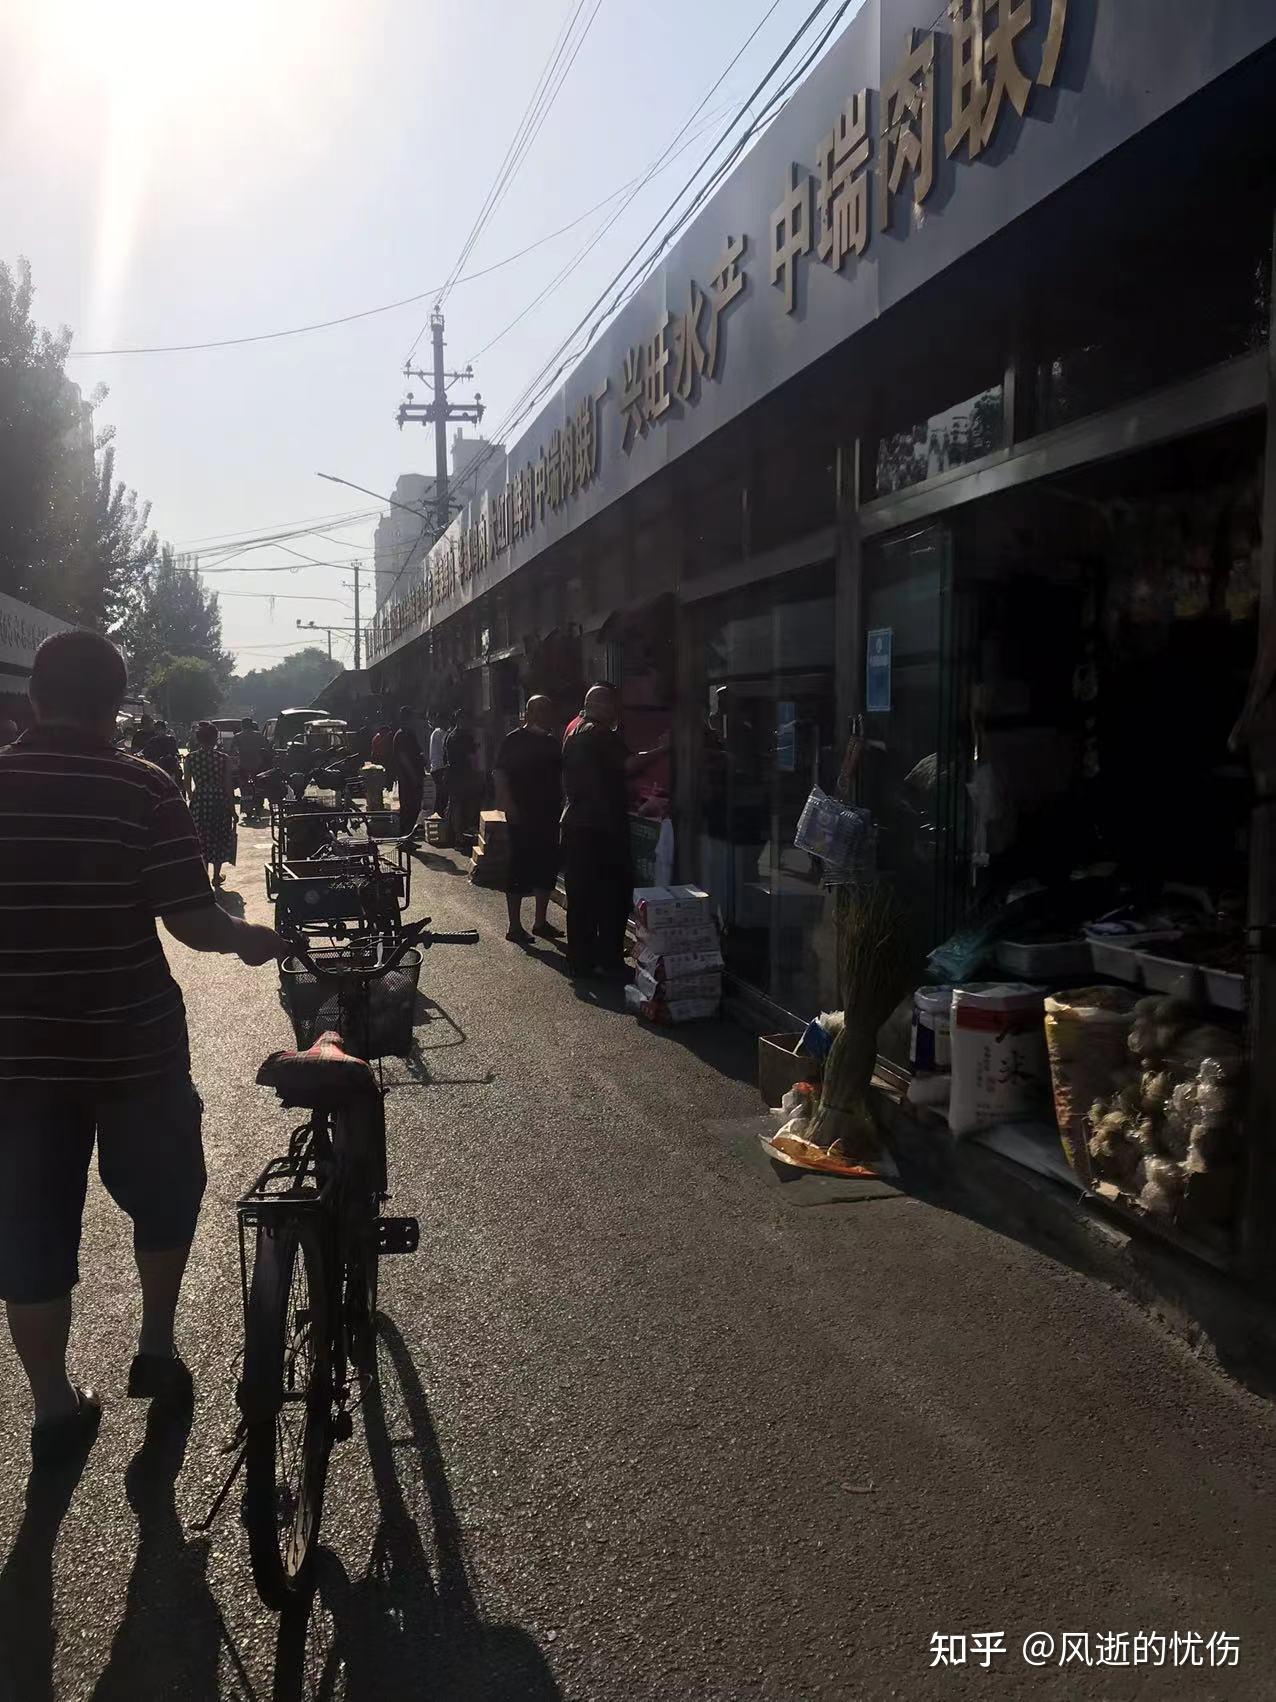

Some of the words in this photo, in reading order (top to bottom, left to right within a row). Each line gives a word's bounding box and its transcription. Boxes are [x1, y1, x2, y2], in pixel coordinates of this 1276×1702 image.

[620, 233, 748, 453] 兴旺水产
[534, 378, 608, 521] 中瑞肉联厂
